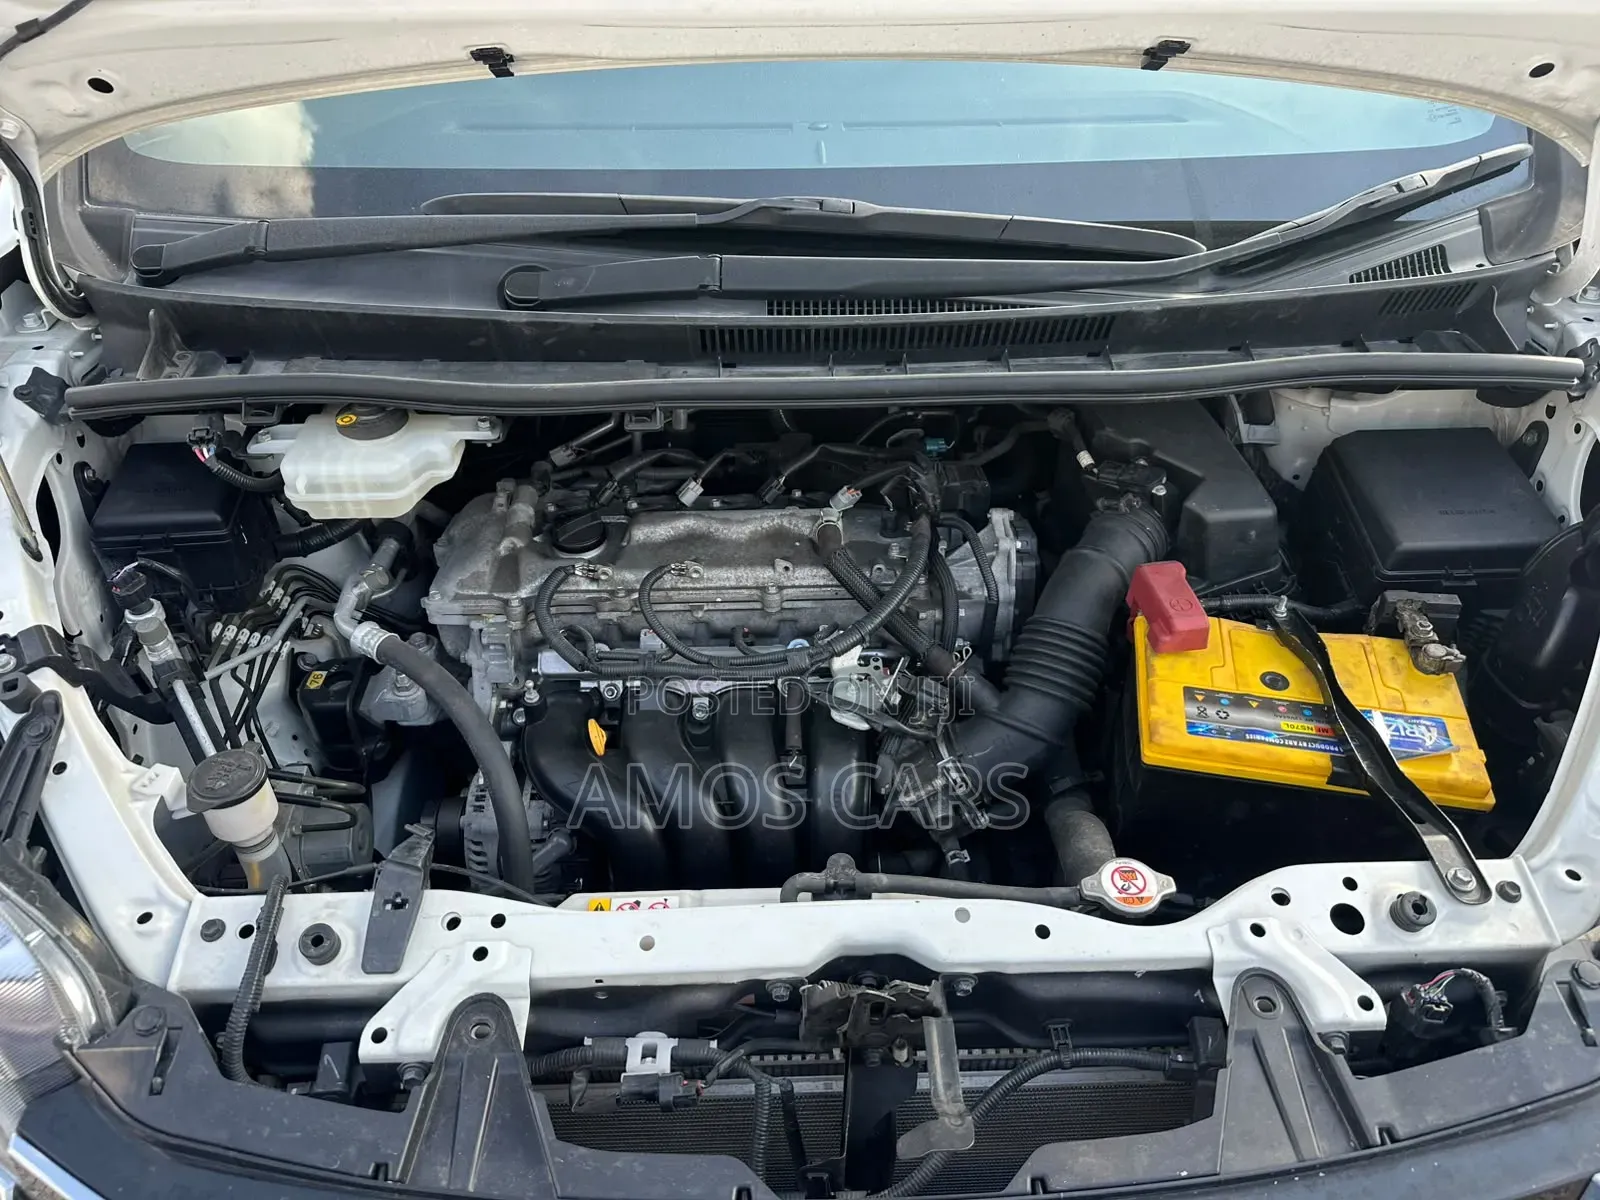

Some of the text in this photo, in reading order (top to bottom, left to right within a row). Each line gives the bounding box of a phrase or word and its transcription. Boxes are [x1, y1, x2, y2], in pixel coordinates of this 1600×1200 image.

[1283, 722, 1314, 732] NS70L
[1245, 733, 1284, 744] COMPANIES
[1308, 742, 1339, 751] PRODUCT
